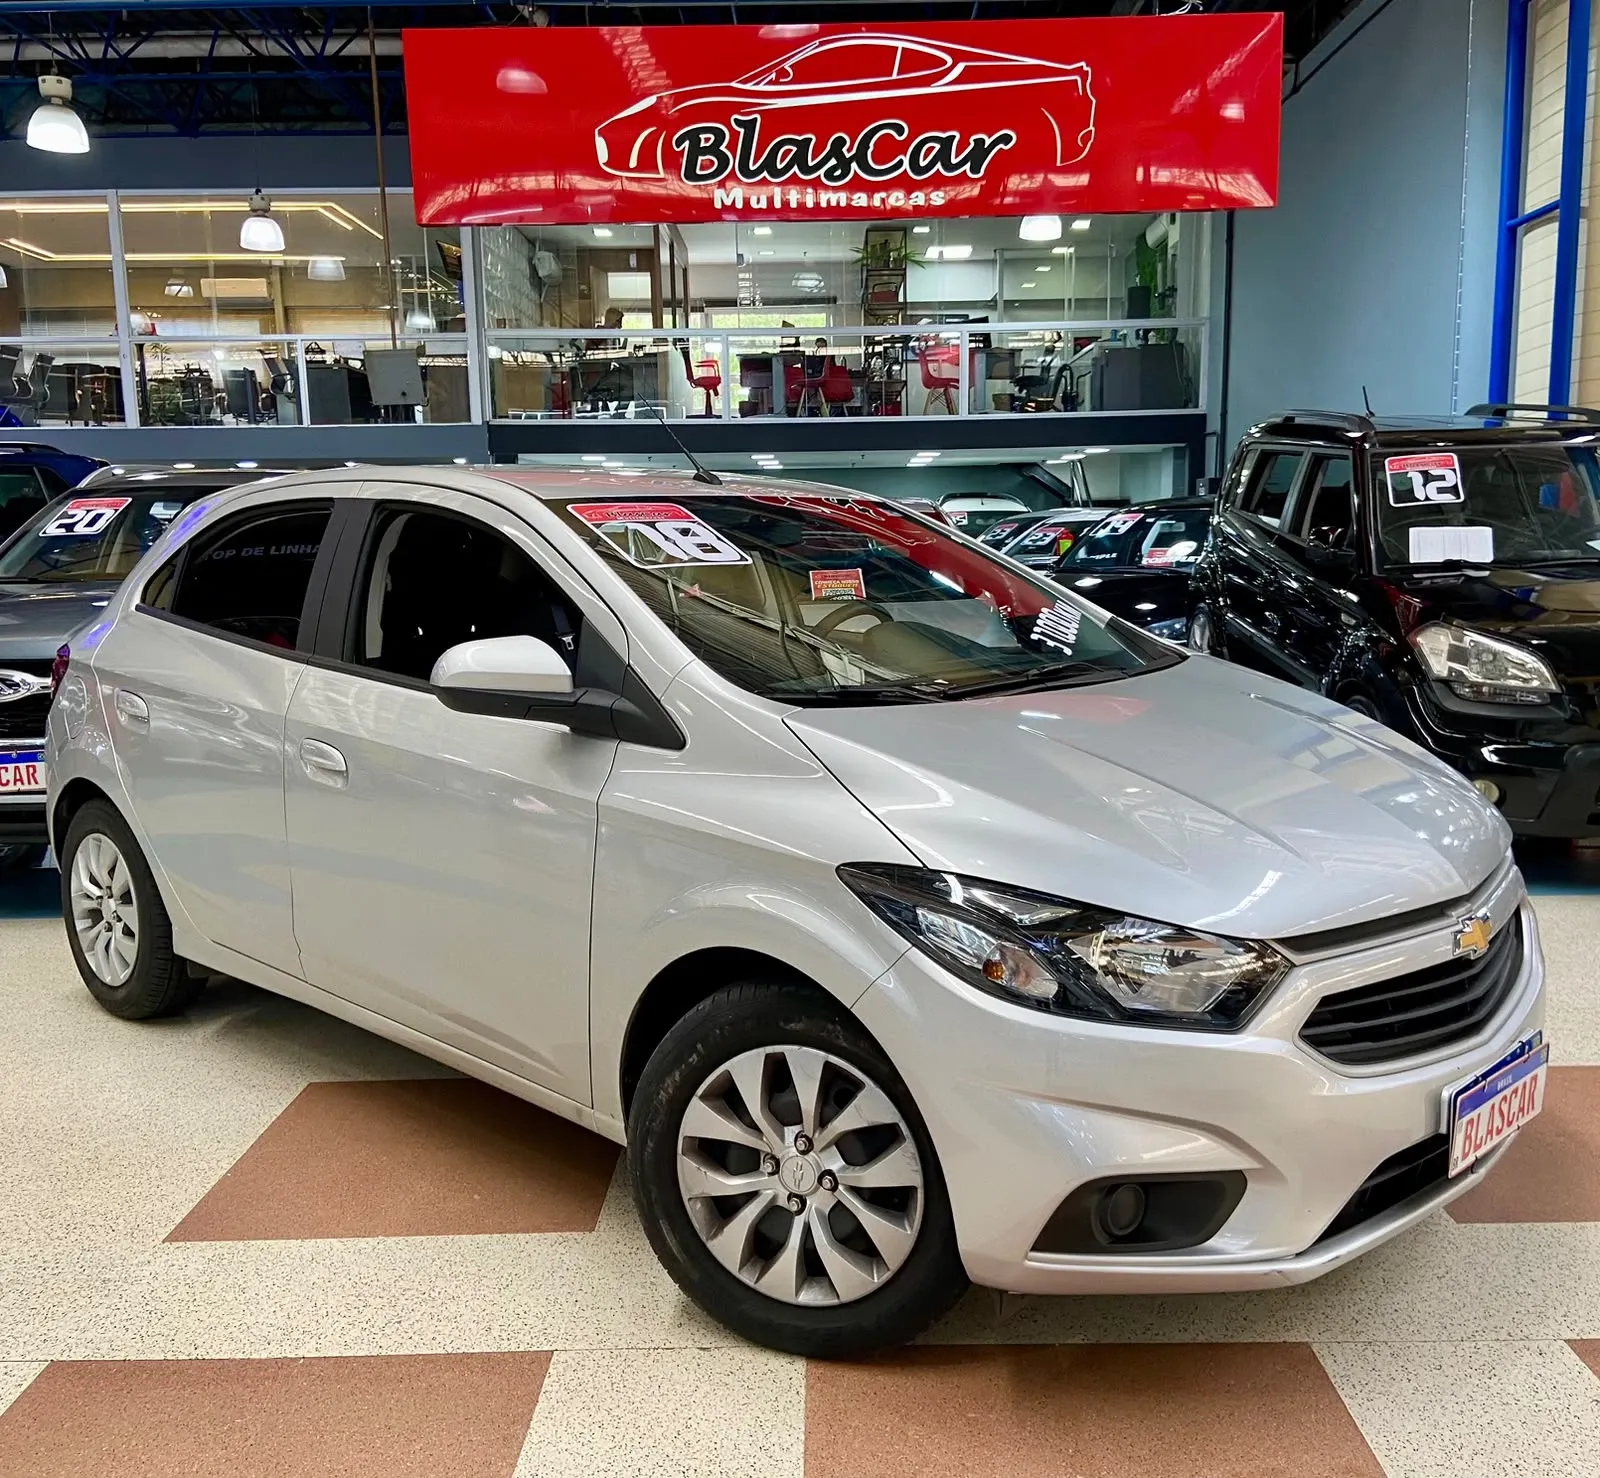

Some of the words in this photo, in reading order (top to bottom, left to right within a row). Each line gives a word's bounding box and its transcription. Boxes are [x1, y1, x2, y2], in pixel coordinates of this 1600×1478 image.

[674, 114, 1015, 185] BlasCar
[713, 187, 946, 210] Multimarcas
[1407, 469, 1457, 501] 12
[46, 510, 116, 534] 20
[205, 549, 237, 560] OP
[241, 546, 265, 557] DE
[624, 521, 741, 561] 18
[1461, 1073, 1538, 1161] BLASCAR
